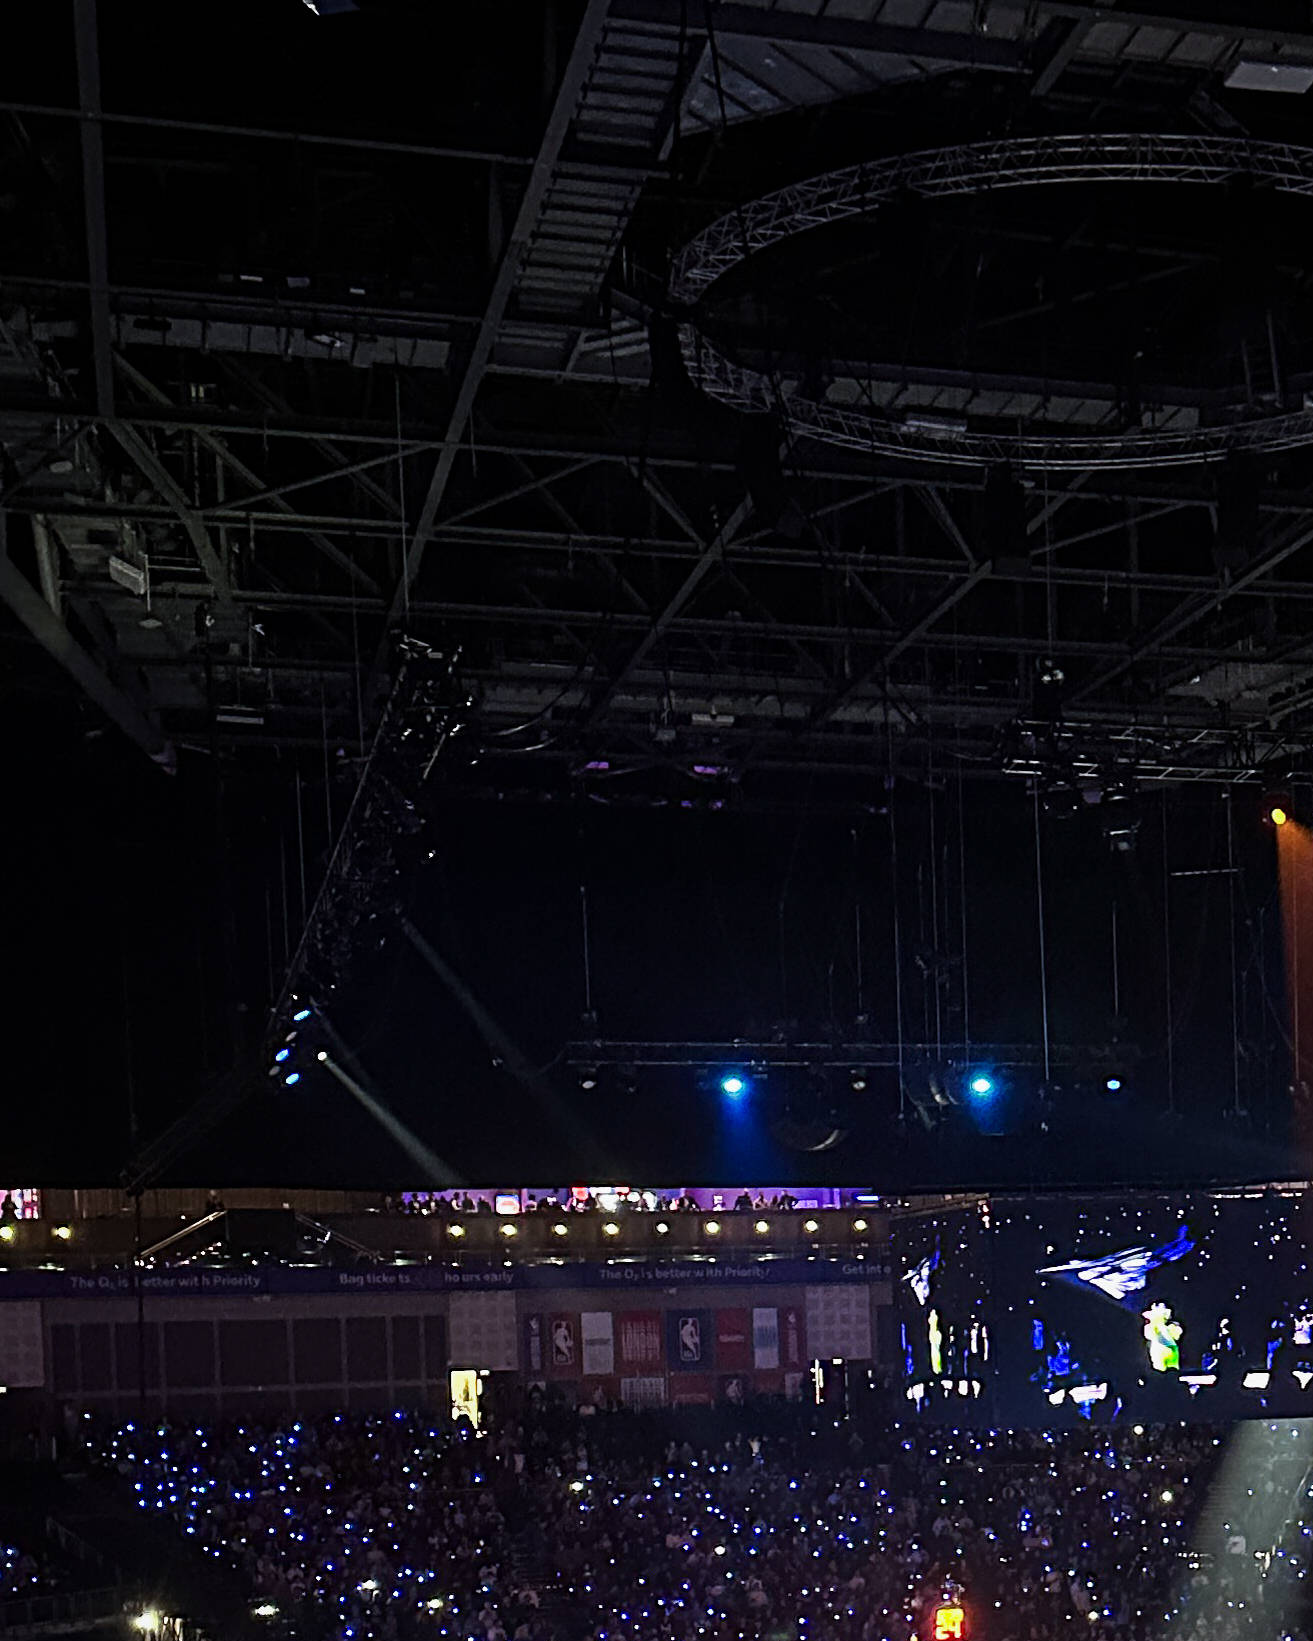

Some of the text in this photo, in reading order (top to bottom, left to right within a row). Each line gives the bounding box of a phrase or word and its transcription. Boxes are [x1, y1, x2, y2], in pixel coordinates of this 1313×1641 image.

[600, 1268, 621, 1280] The
[655, 1267, 693, 1279] better
[694, 1267, 722, 1279] with
[725, 1266, 770, 1280] Priority
[70, 1276, 97, 1288] The
[180, 1275, 210, 1287] with
[213, 1275, 261, 1288] Priority
